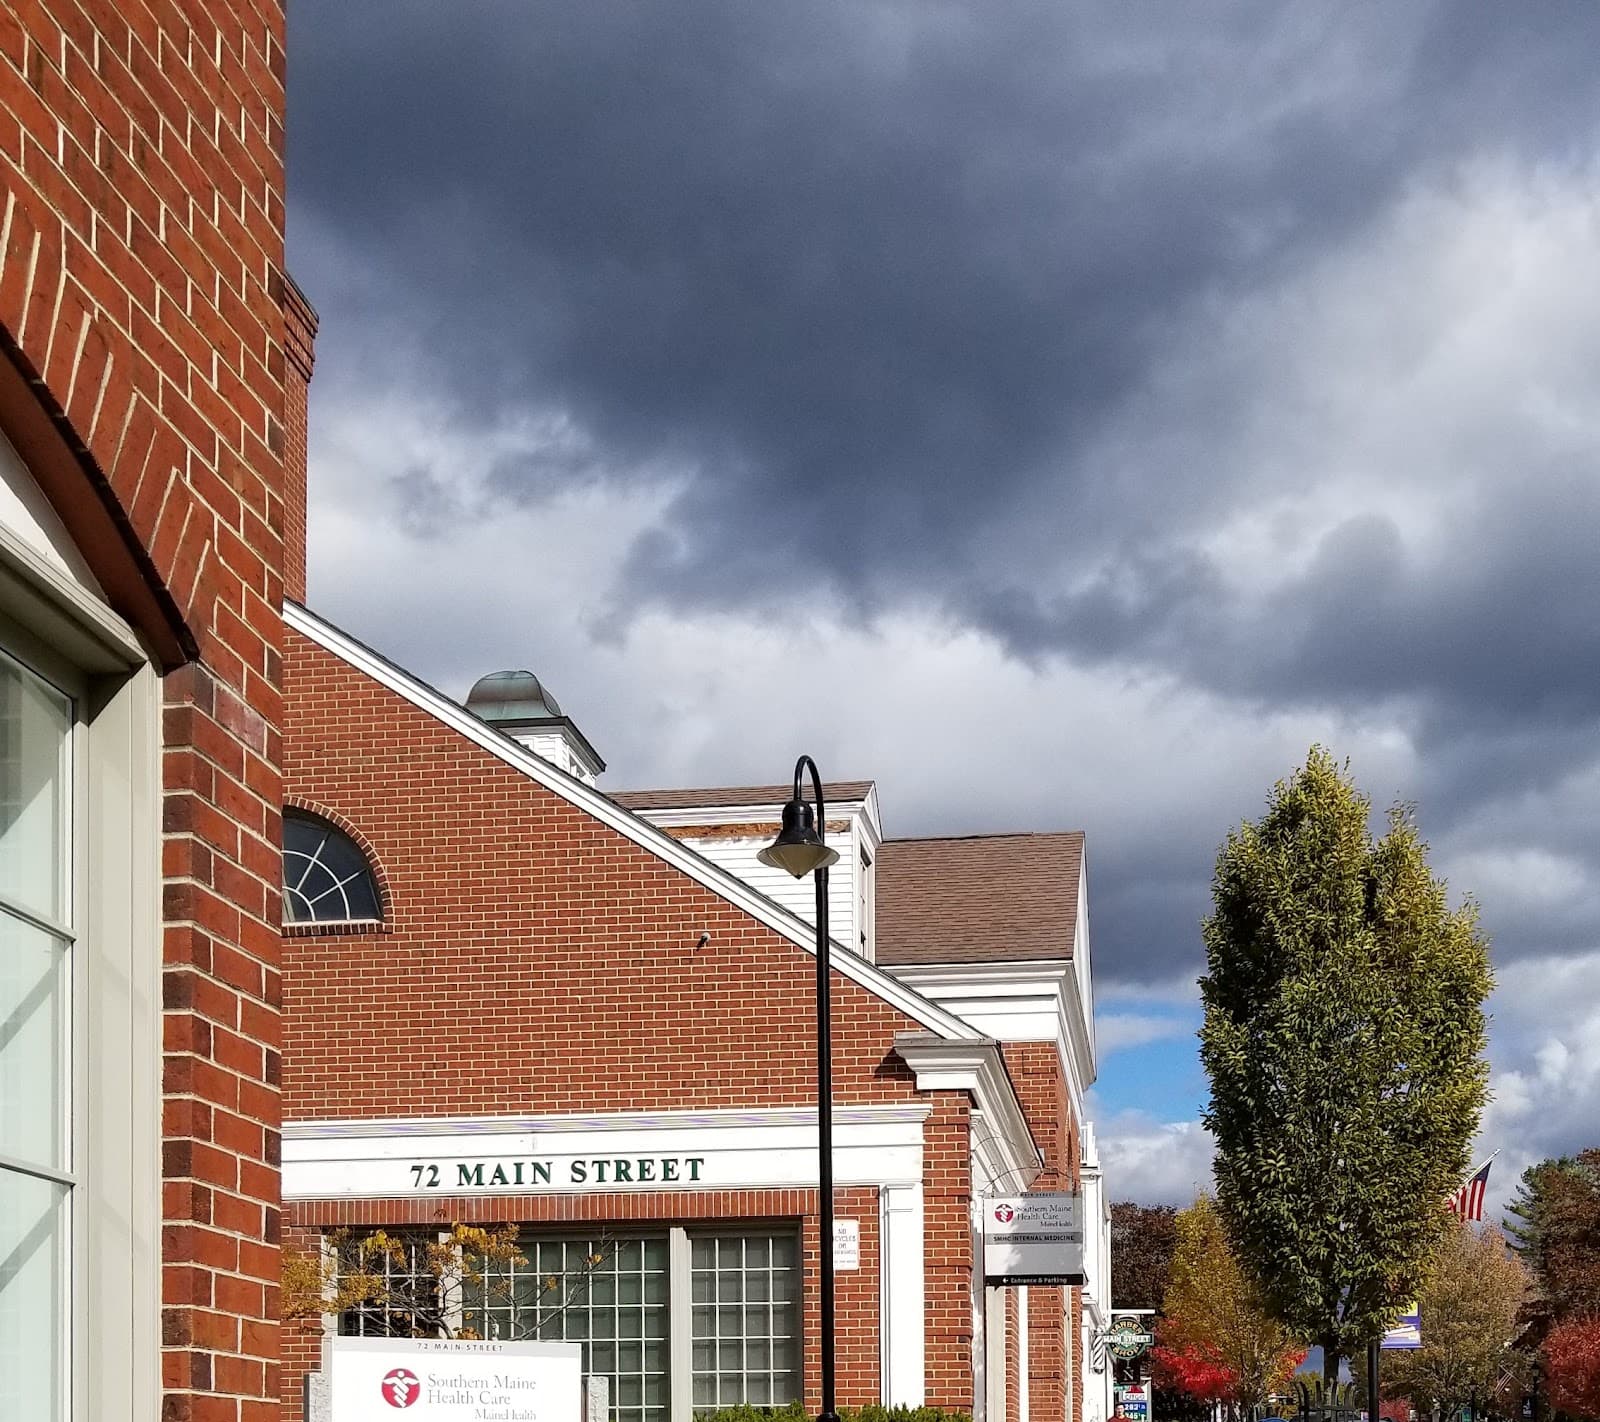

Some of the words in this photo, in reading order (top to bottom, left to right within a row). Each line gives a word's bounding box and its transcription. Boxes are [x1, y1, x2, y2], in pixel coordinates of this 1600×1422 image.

[410, 1164, 441, 1188] 72
[456, 1161, 553, 1187] MAIN
[570, 1157, 705, 1184] STREET
[1016, 1204, 1048, 1212] Southern
[1049, 1204, 1072, 1212] Maine
[1017, 1212, 1040, 1220] Health
[1042, 1212, 1059, 1220] Care
[1043, 1277, 1068, 1285] Parking
[1110, 1321, 1143, 1335] BARBER
[1103, 1334, 1122, 1343] MAIN
[1125, 1334, 1151, 1343] STREET
[417, 1342, 429, 1350] 72
[434, 1343, 461, 1351] MAIN
[466, 1344, 503, 1352] STREET
[1112, 1345, 1140, 1357] SHOP
[427, 1373, 489, 1389] Southern
[493, 1374, 537, 1390] Maine
[428, 1389, 475, 1405] Health
[478, 1390, 511, 1405] Care
[474, 1408, 537, 1421] MaineHealth
